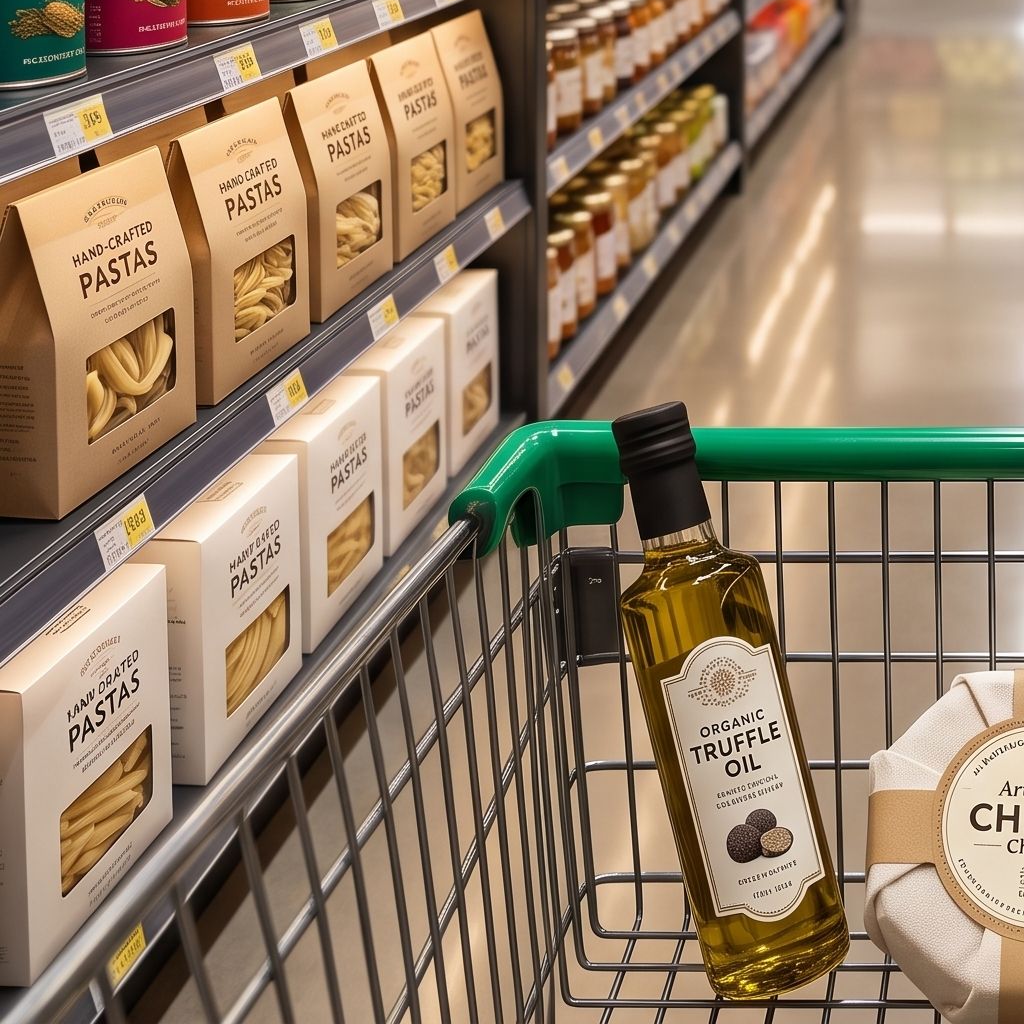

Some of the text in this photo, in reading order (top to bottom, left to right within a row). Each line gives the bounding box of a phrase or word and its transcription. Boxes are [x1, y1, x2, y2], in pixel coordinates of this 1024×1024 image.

[328, 126, 371, 163] PASTAS
[225, 174, 282, 221] PASTAS
[72, 220, 153, 268] HAND-CRAFTED
[79, 240, 158, 299] PASTAS
[331, 447, 368, 494] PASTAS
[230, 535, 281, 598] PASTAS
[68, 668, 140, 754] PASTAS
[699, 709, 765, 739] ORGANIC
[690, 720, 782, 765] TRUFFLE
[724, 753, 762, 778] OIL
